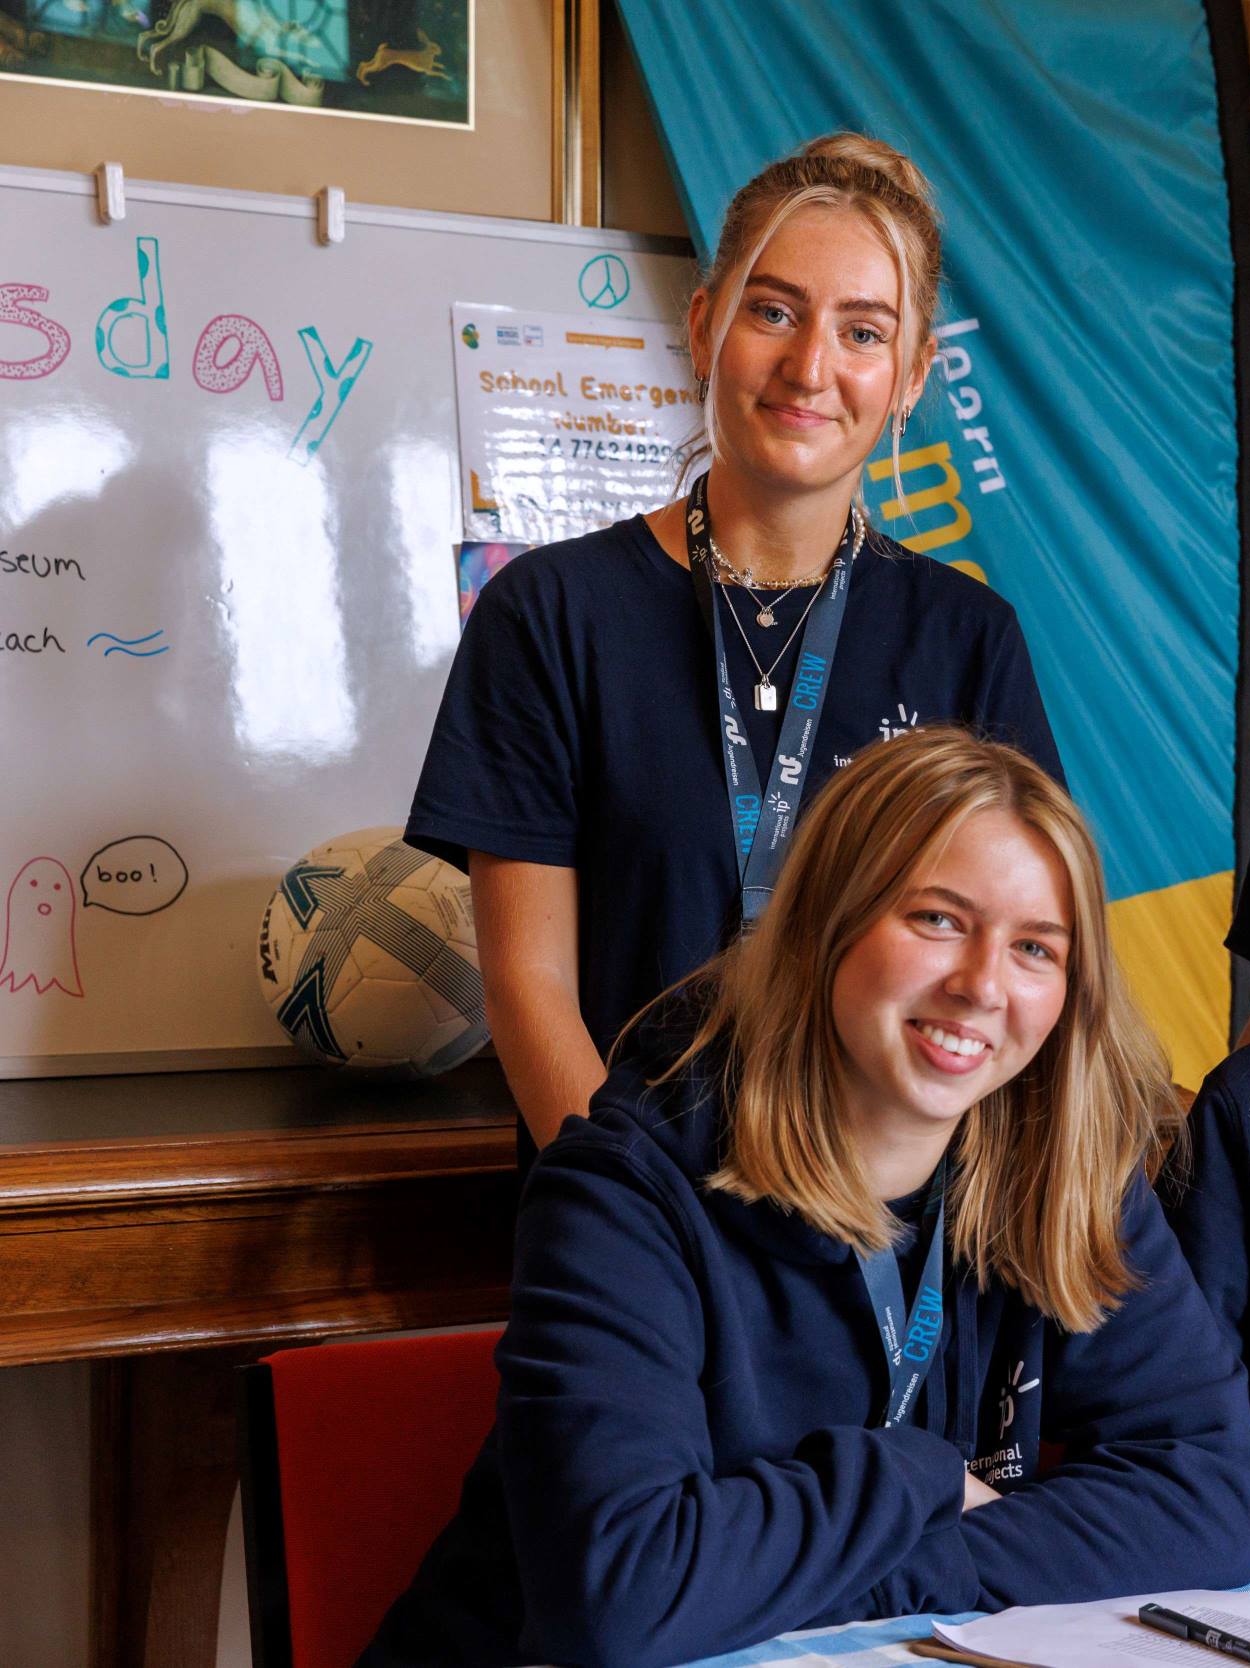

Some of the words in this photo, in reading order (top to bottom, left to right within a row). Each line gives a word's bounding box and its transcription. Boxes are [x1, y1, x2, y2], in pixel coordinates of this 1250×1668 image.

[479, 370, 568, 398] School
[931, 318, 1006, 494] learn
[0, 627, 66, 654] ach
[792, 653, 828, 711] CREW
[797, 718, 813, 758] Jugendreisen
[727, 743, 740, 786] Jugendreisen
[770, 814, 784, 850] international
[780, 815, 791, 838] projects
[97, 863, 158, 884] boo!
[903, 1286, 943, 1361] CREW
[894, 1372, 920, 1423] Jugendreisen
